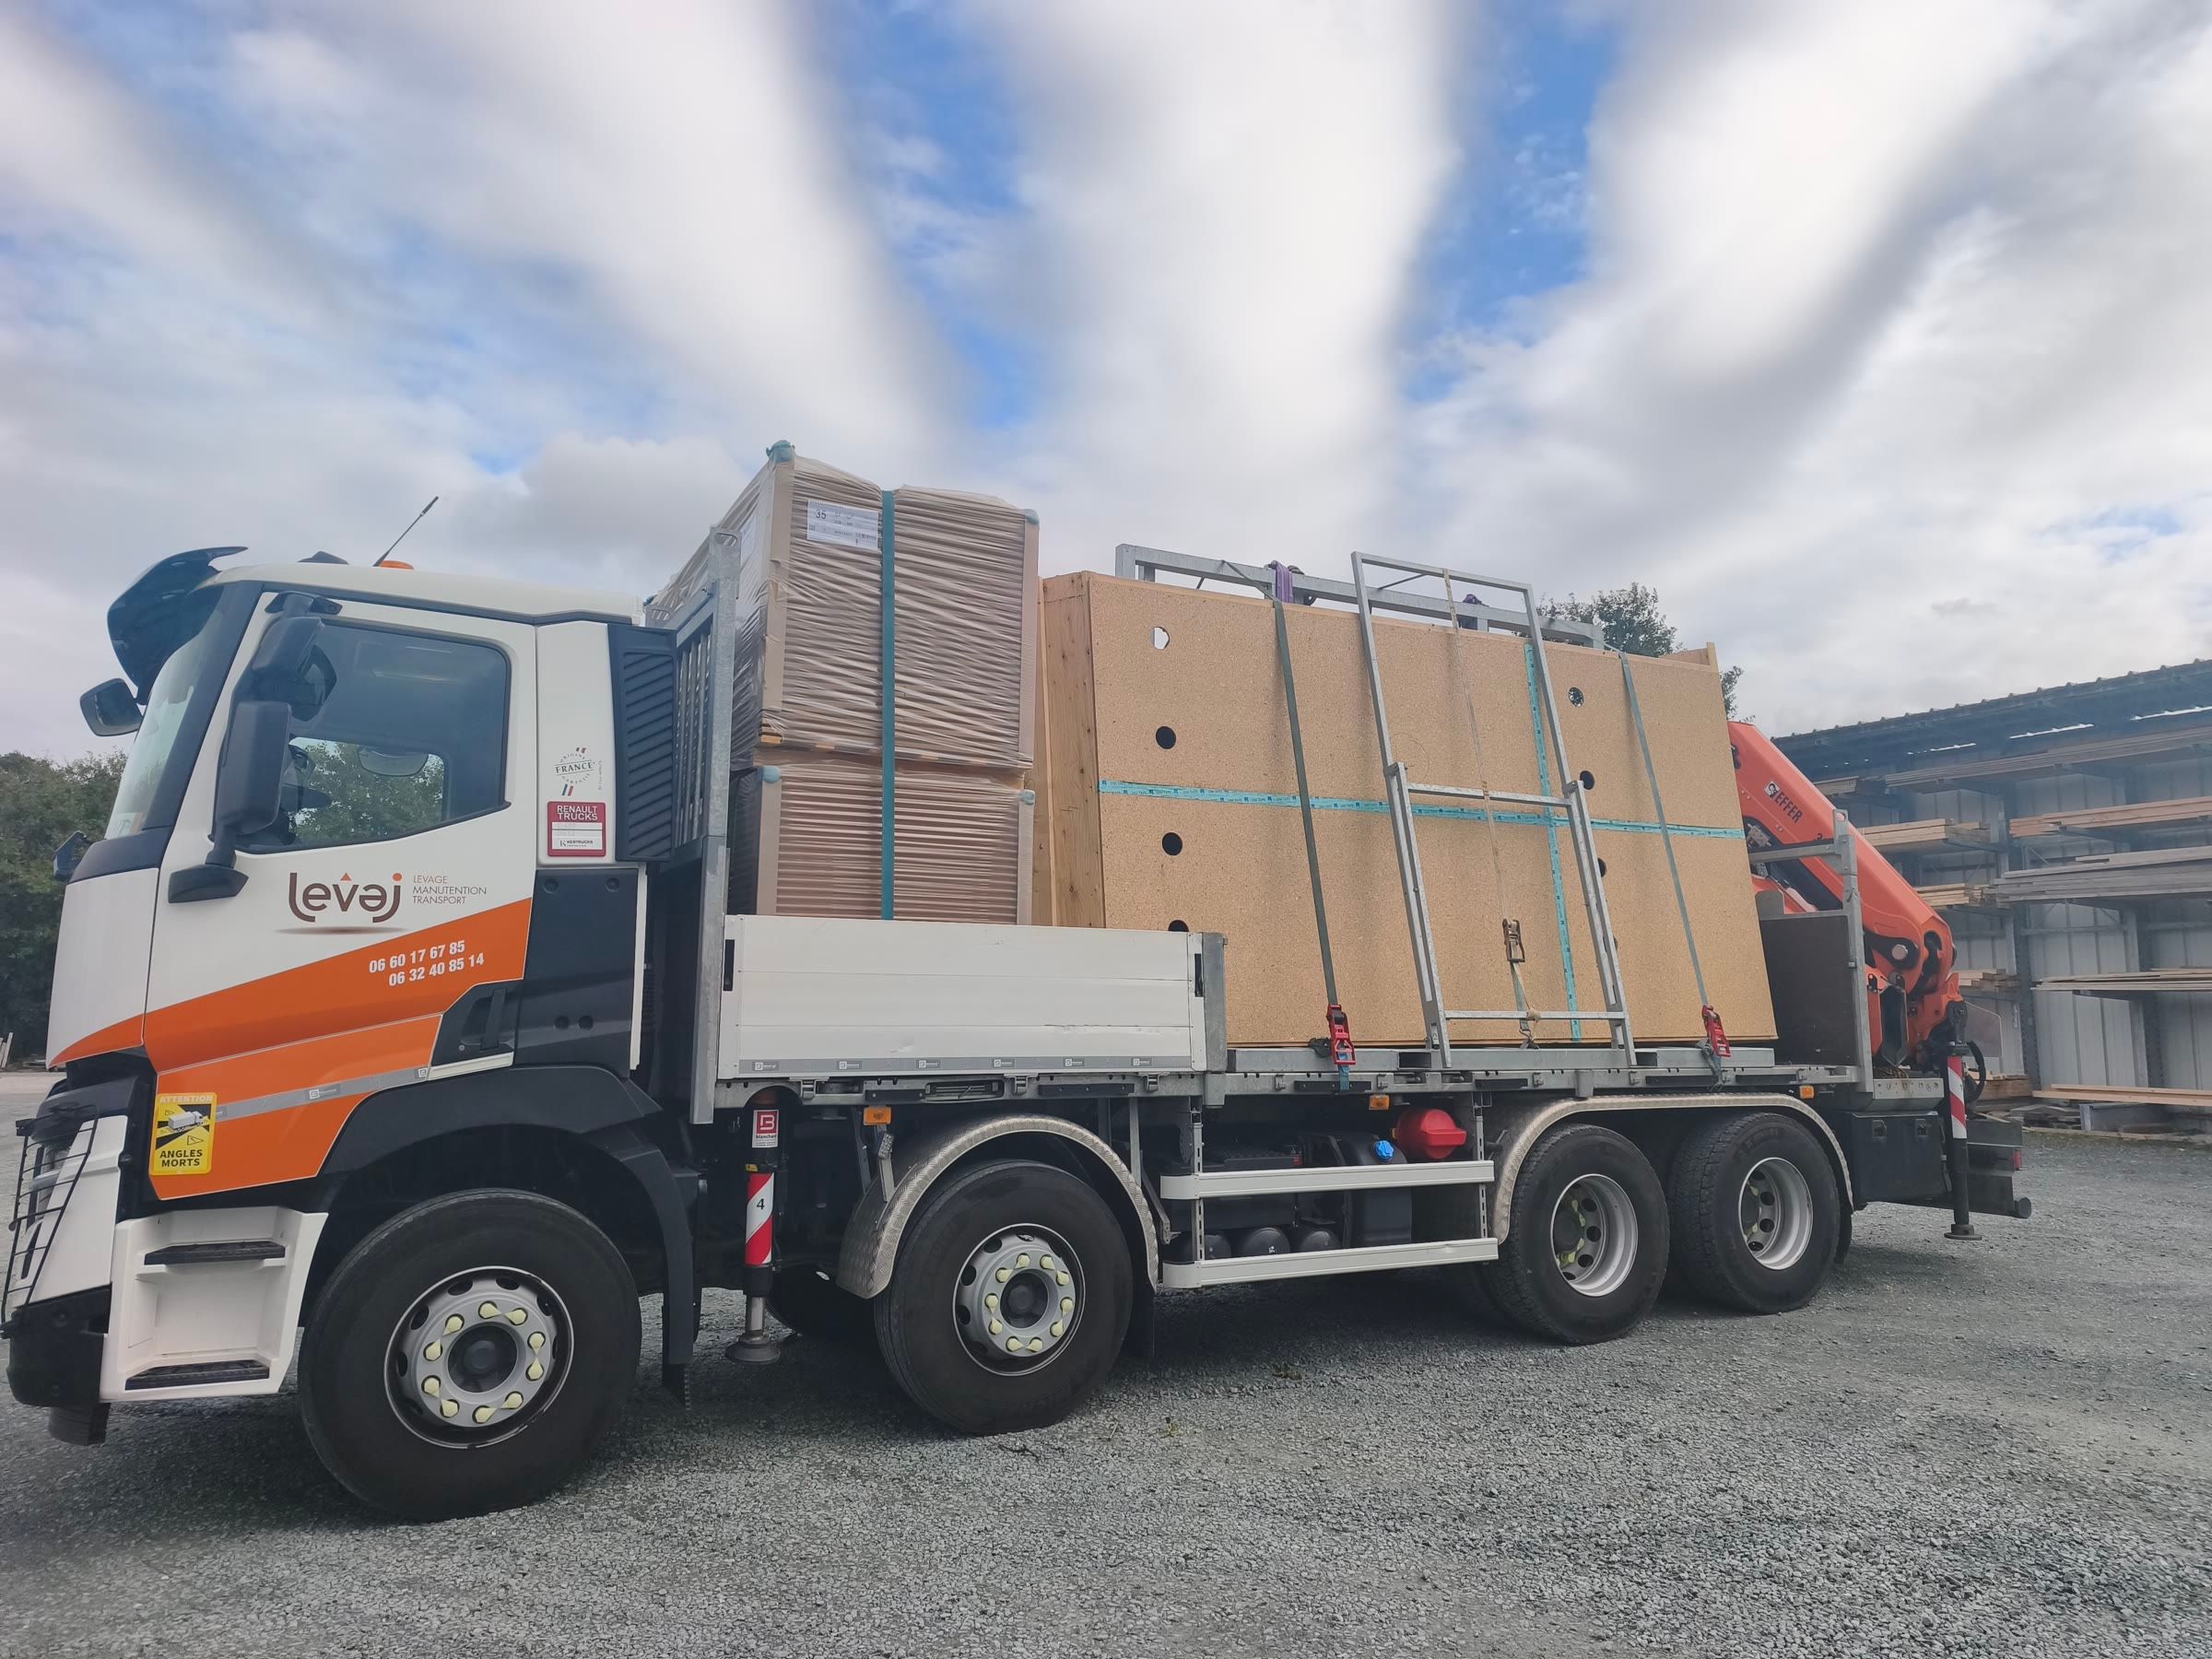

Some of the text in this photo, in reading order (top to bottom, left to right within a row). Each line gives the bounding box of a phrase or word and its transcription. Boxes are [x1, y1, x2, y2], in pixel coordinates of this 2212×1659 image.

[816, 509, 827, 520] 35
[556, 761, 593, 773] FRANCE
[557, 805, 598, 813] RENAULT
[1775, 792, 1803, 823] EFFER
[557, 812, 598, 820] TRUCKS
[413, 875, 448, 884] LEVAGE
[413, 886, 487, 895] MANUTENTION
[413, 895, 466, 904] TRANSPORT
[369, 940, 465, 973] 06 60 17 67 85
[389, 953, 485, 986] 06 32 40 85 14
[161, 1094, 214, 1103] ATTENTION
[159, 1149, 203, 1159] ANGLES
[161, 1159, 200, 1168] MORTS
[756, 1198, 765, 1210] 4
